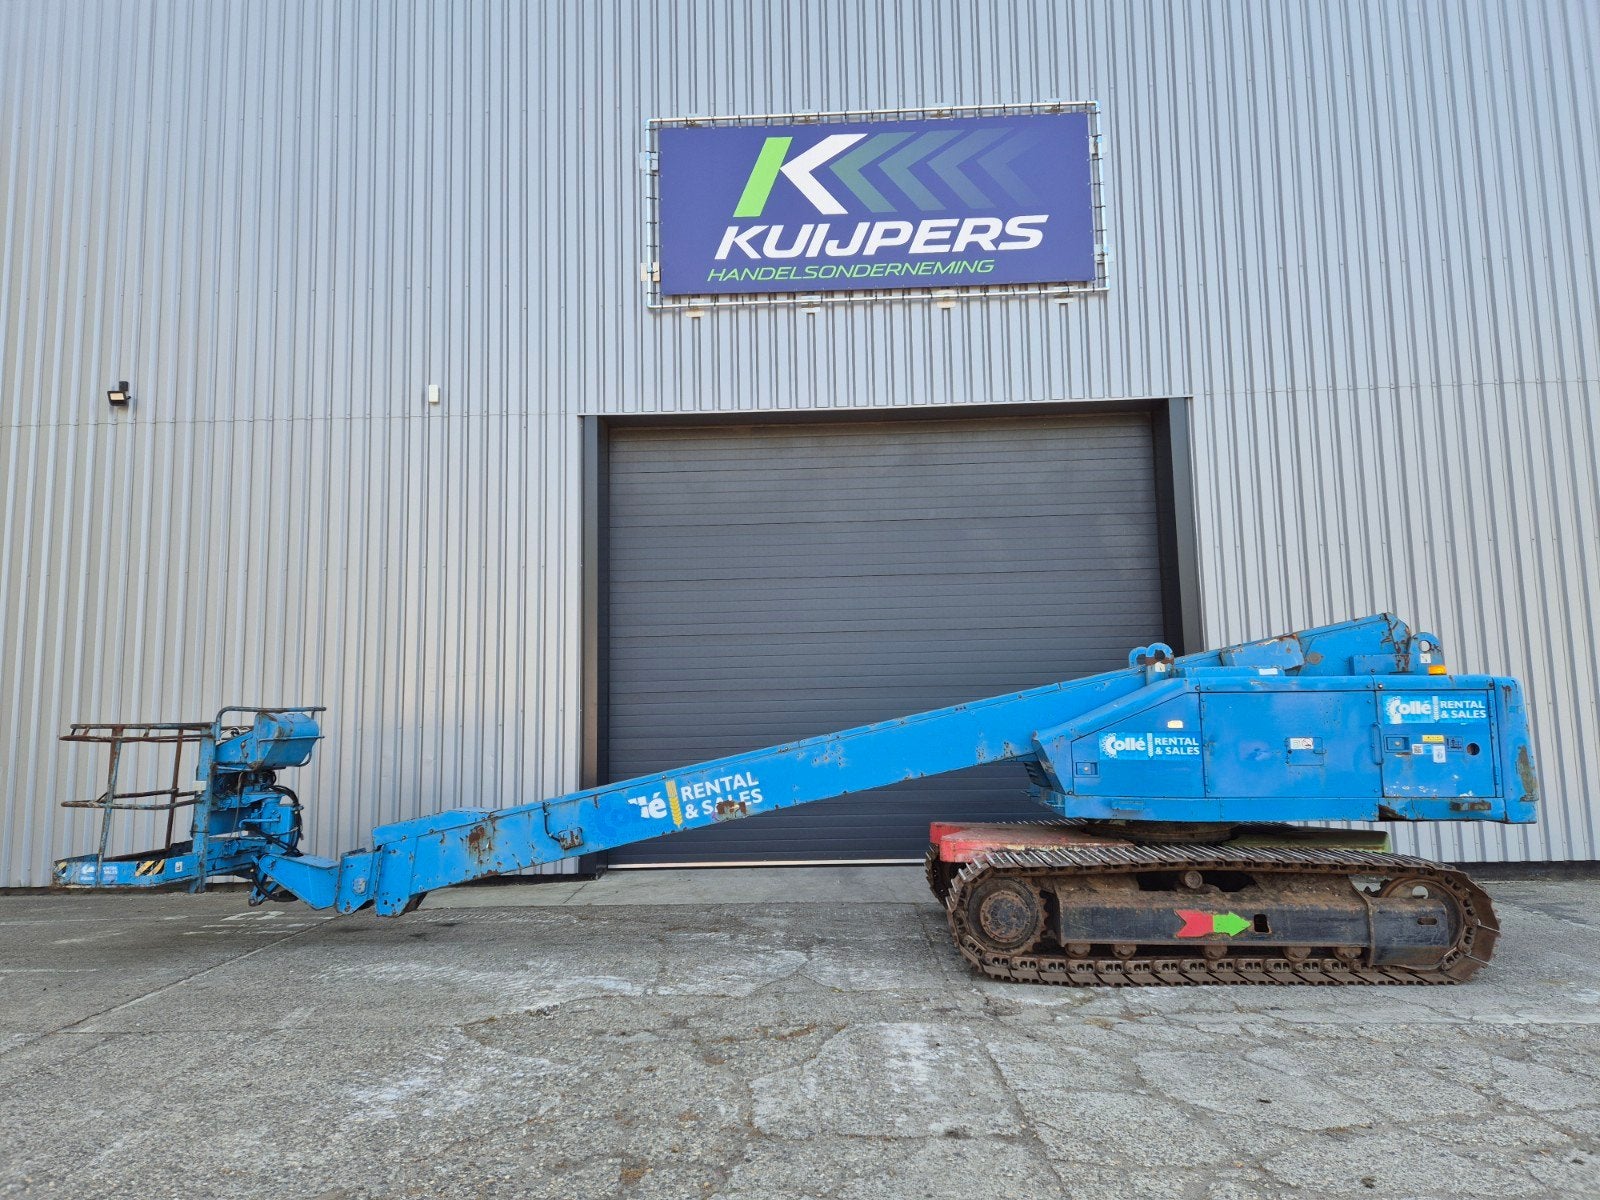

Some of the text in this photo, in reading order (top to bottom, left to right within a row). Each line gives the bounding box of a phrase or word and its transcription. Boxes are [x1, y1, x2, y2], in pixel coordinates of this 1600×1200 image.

[714, 214, 1049, 260] KUIJPERS
[707, 259, 995, 282] HANDELSONDERNEMING
[1440, 700, 1486, 709] RENTAL
[1440, 709, 1487, 719] & SALES
[1154, 737, 1199, 746] RENTAL
[1155, 746, 1200, 755] & SALES
[680, 771, 760, 802] RENTAL
[685, 803, 699, 819] &
